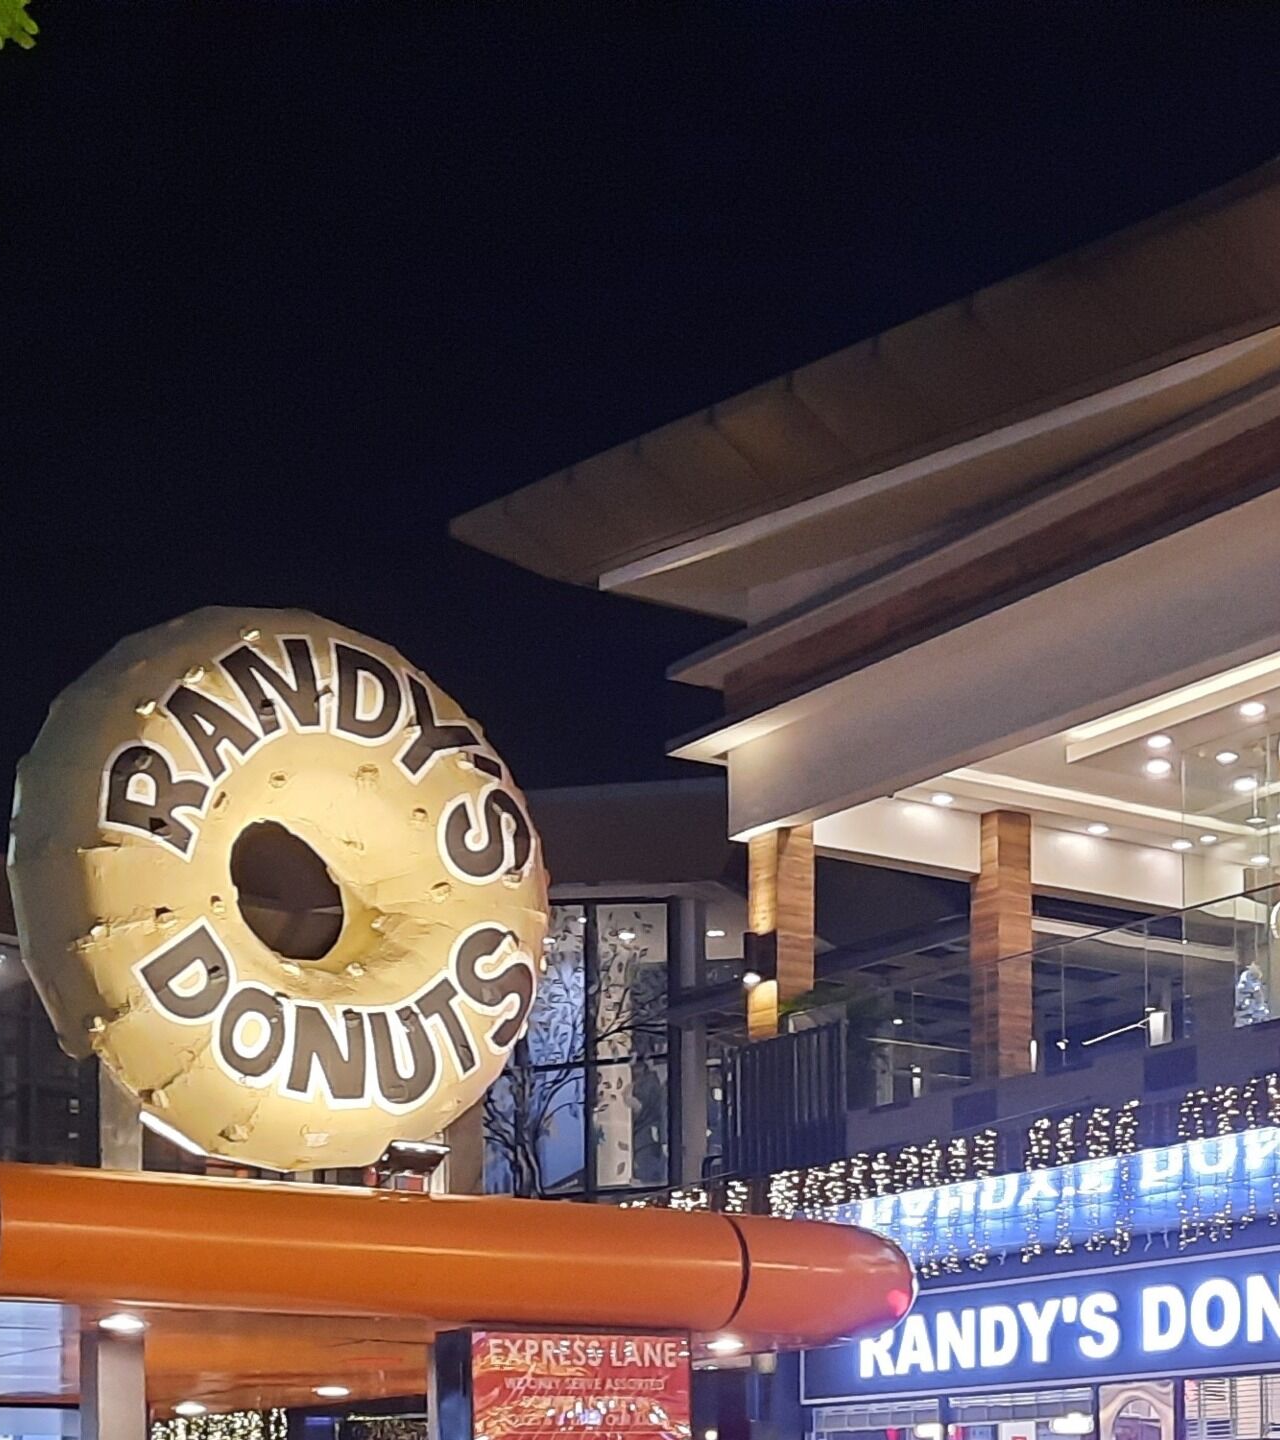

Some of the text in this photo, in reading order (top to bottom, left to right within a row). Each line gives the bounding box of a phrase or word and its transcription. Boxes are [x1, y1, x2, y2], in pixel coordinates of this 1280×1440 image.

[98, 633, 538, 886] RANDY'S
[133, 914, 537, 1115] DONUTS
[488, 1338, 679, 1369] EXPRESS LANE
[858, 1291, 1120, 1380] RANDY'S
